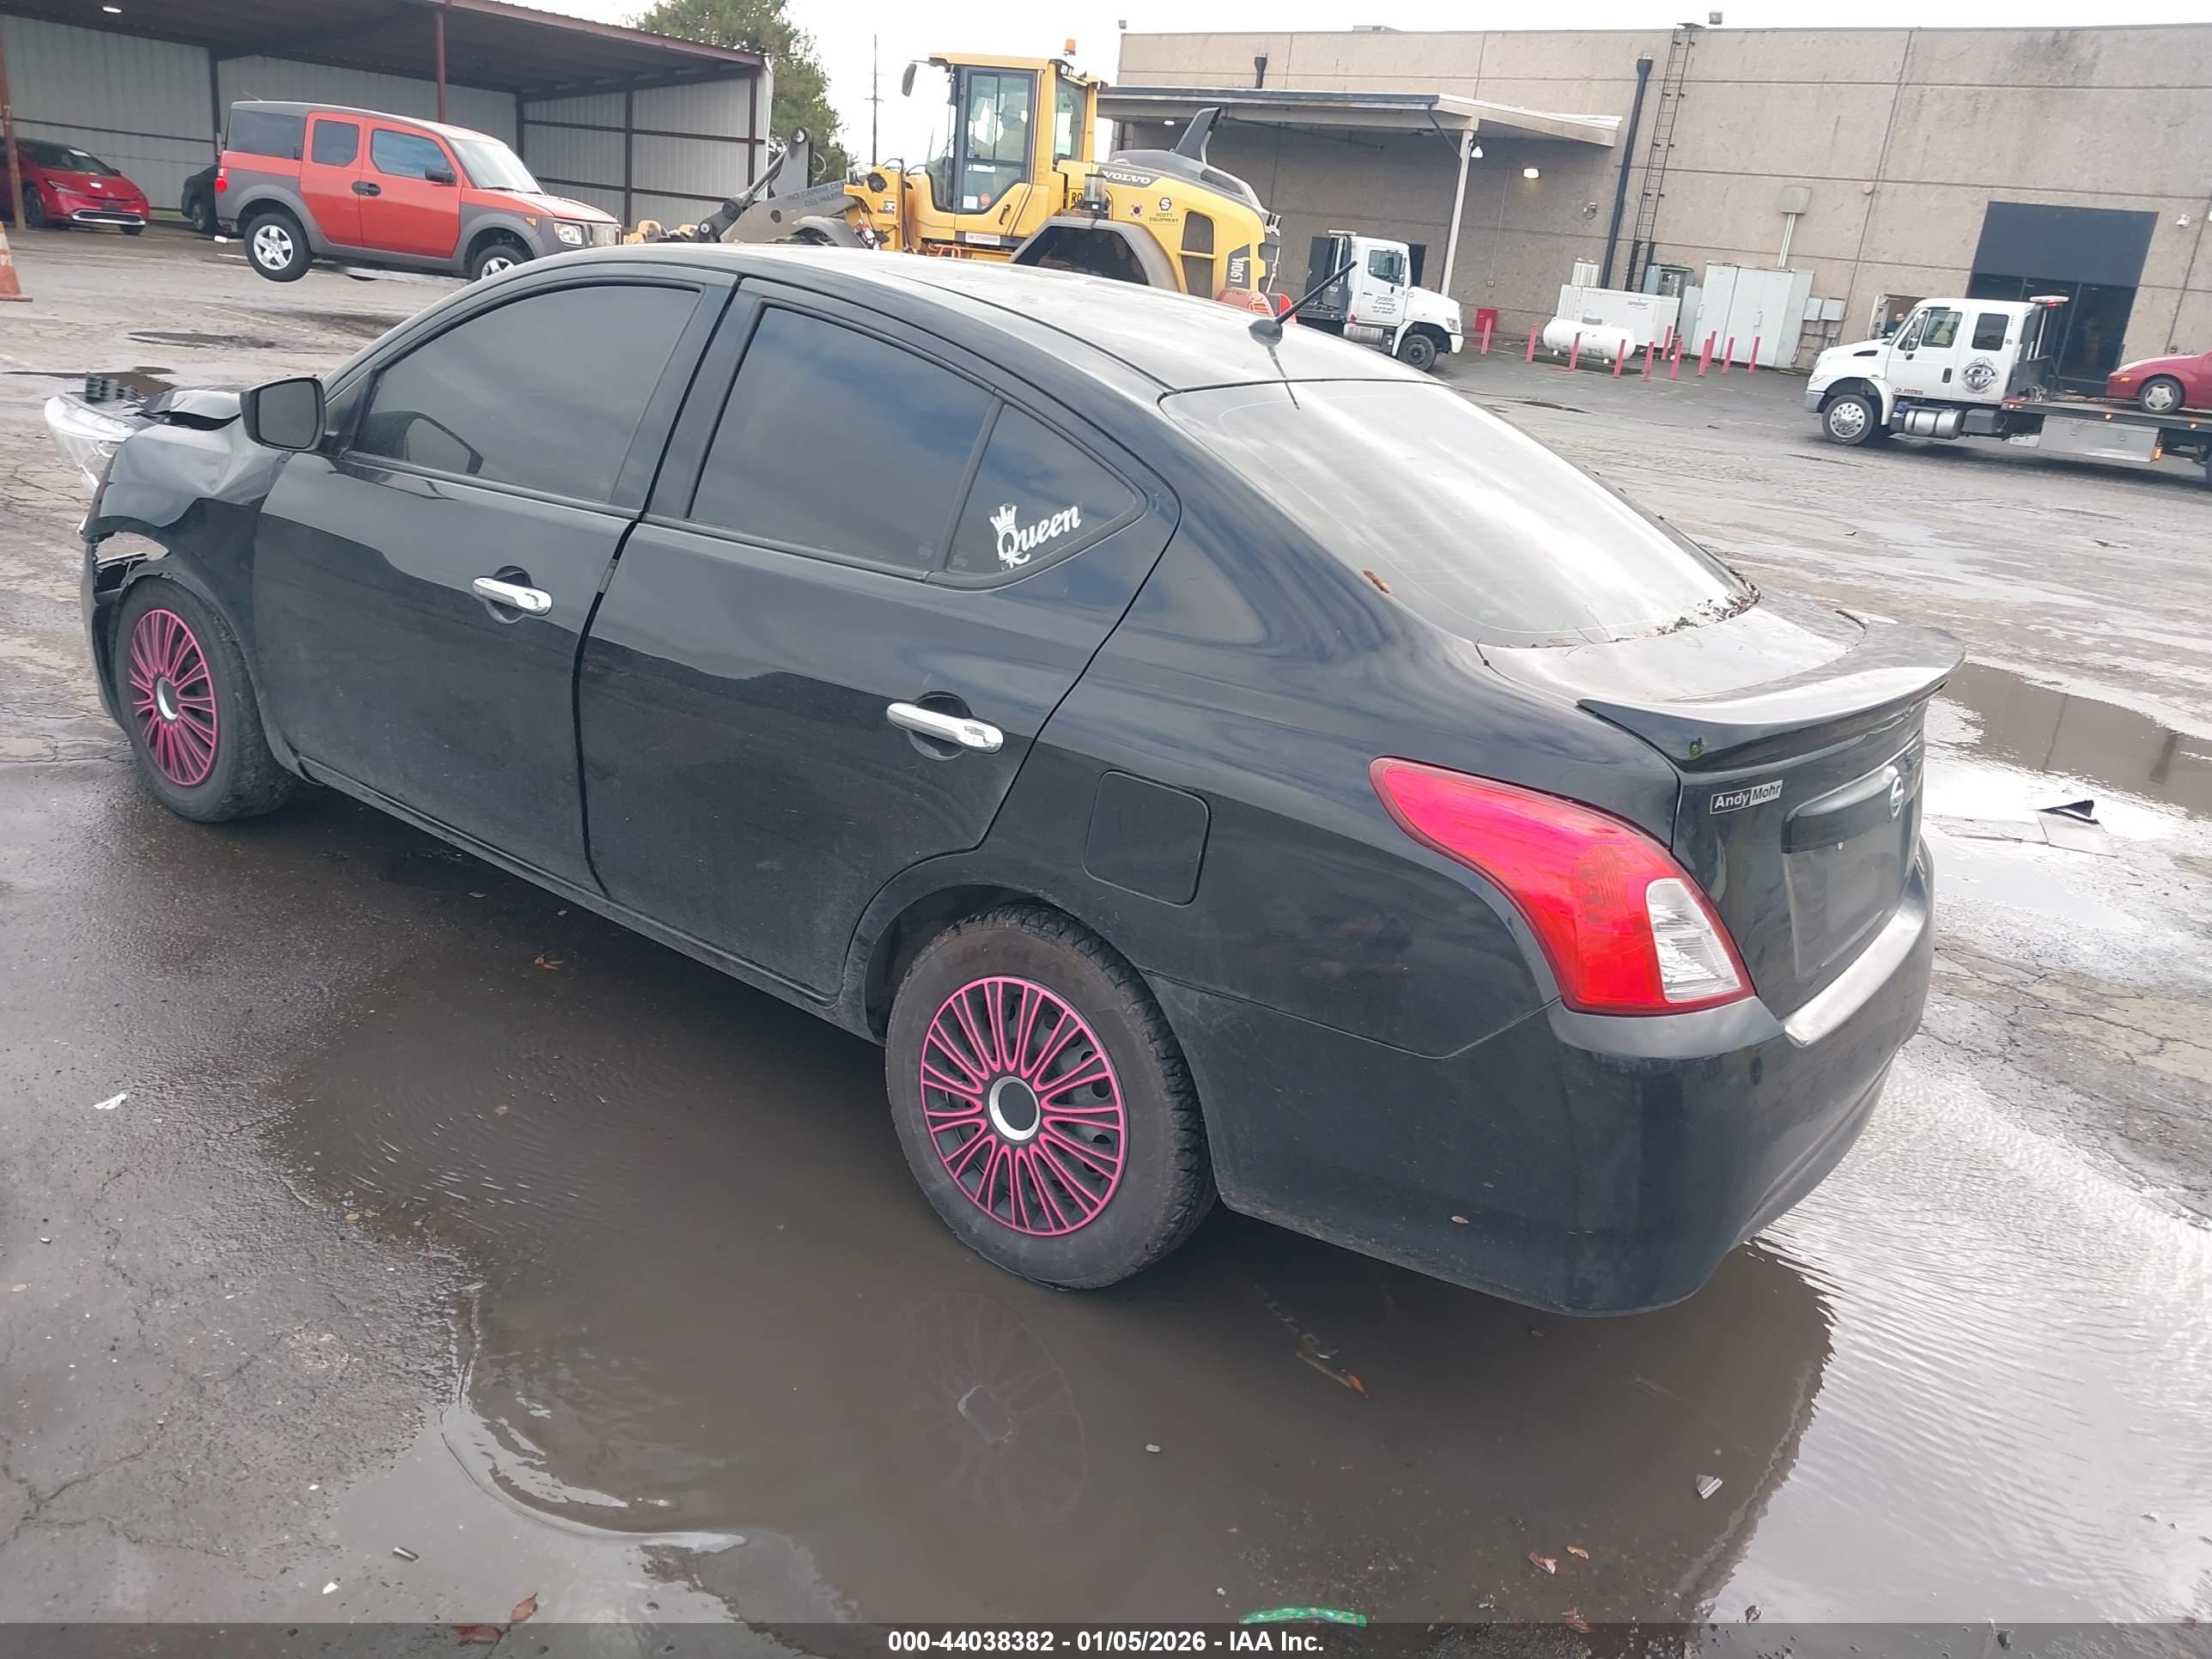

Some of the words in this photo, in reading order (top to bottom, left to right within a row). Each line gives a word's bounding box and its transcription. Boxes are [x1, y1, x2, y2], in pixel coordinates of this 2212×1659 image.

[1102, 170, 1152, 185] VOLVO
[1230, 258, 1245, 283] L90H
[997, 506, 1082, 568] Queen
[1714, 792, 1750, 808] Andy
[1752, 785, 1780, 800] Mohr
